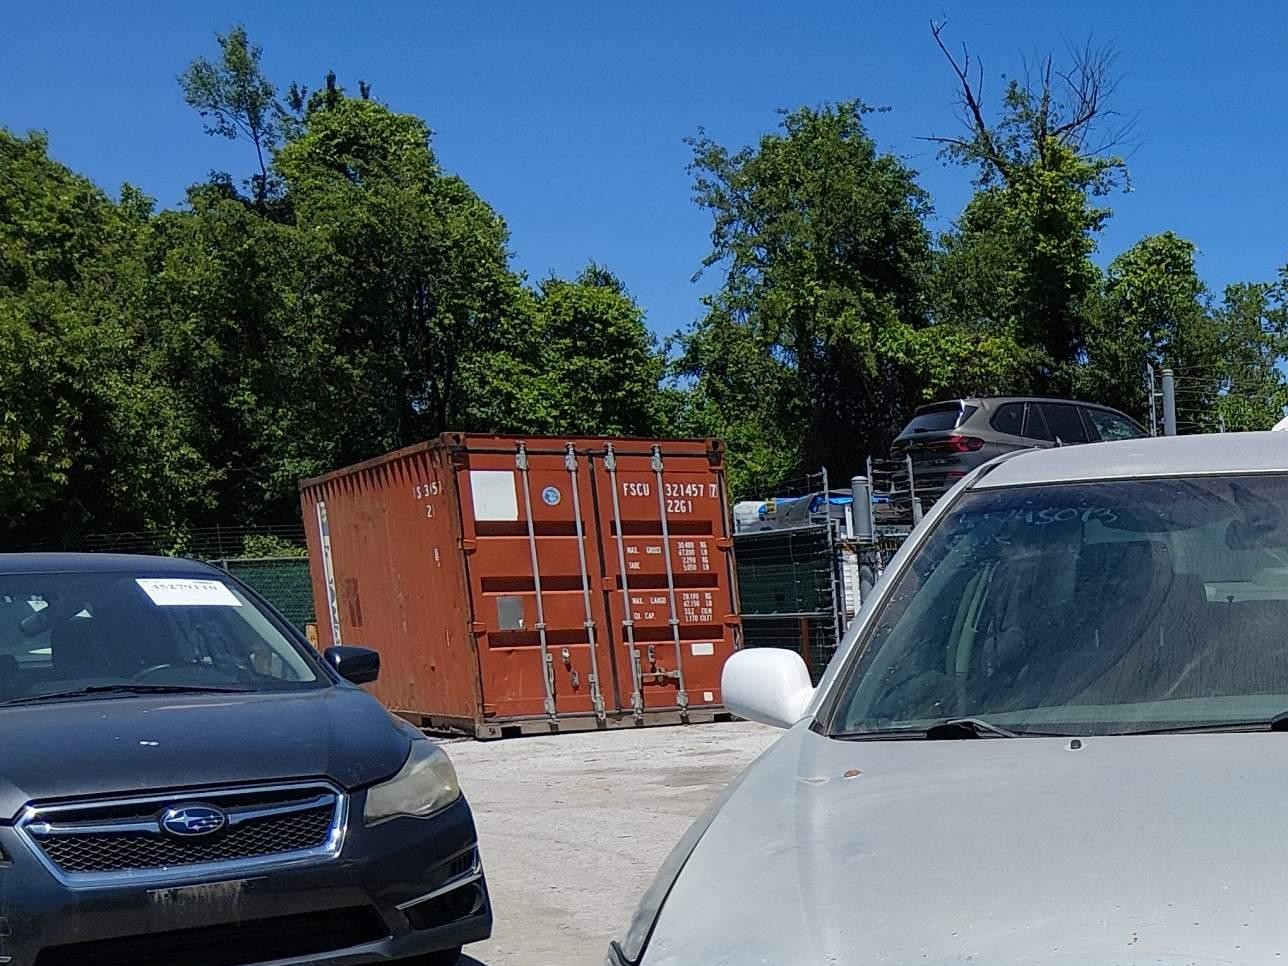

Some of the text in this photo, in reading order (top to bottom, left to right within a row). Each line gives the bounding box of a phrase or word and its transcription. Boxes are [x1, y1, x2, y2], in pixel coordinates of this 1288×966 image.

[623, 483, 650, 496] FSCU
[665, 483, 704, 496] 321457
[667, 499, 692, 513] 22G1
